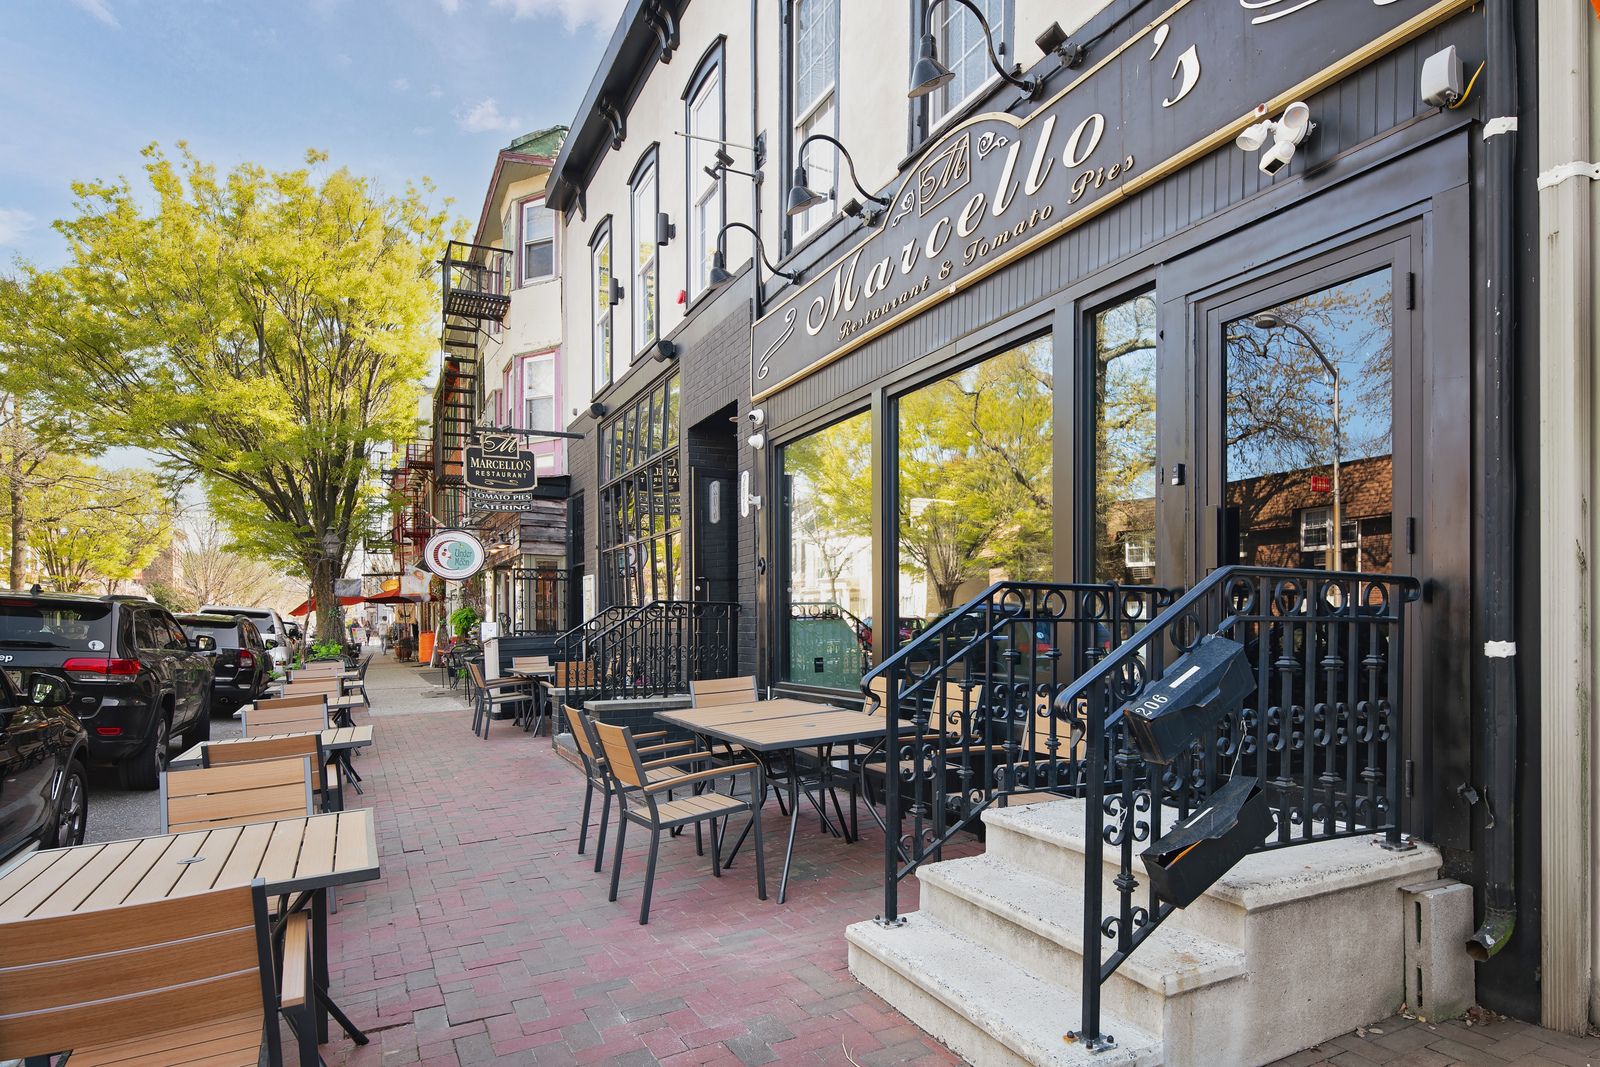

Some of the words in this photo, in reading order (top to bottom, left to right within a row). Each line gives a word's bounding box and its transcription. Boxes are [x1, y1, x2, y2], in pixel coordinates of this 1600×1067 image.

[920, 133, 969, 205] M
[806, 24, 1201, 336] Marcello's
[837, 275, 930, 341] Restaurant
[938, 260, 953, 280] &
[962, 205, 1053, 266] Tomato
[1067, 155, 1135, 204] Pies
[483, 435, 518, 454] M
[470, 456, 532, 471] MARCELLO'S
[475, 470, 527, 479] RESTAURANT
[472, 491, 511, 501] TOMATO
[473, 502, 531, 511] CATERING
[454, 548, 473, 558] Under
[454, 557, 470, 567] Moon
[0, 654, 13, 663] ep
[1135, 694, 1168, 717] 206
